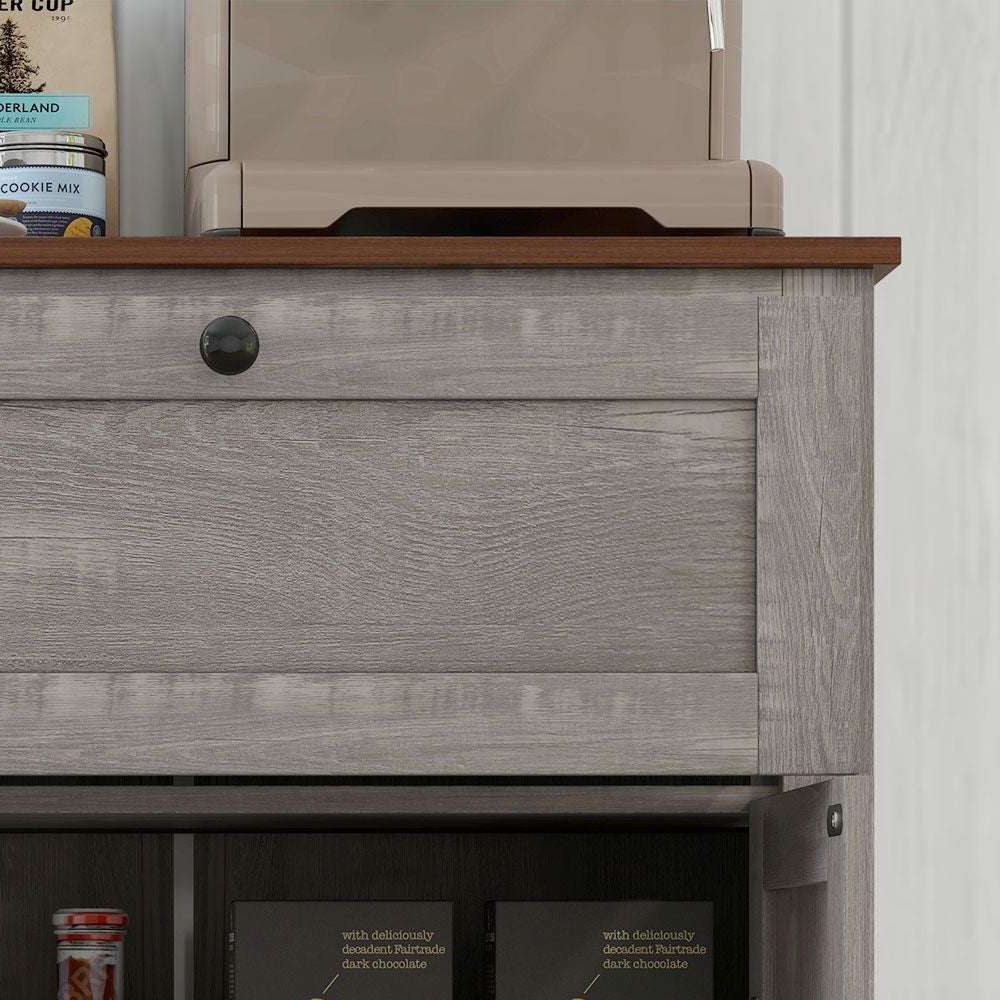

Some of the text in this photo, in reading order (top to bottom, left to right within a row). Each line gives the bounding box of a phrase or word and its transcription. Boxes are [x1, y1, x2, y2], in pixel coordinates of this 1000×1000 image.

[31, 0, 73, 11] CUP
[14, 116, 38, 124] BEAN
[0, 182, 53, 194] COOKIE
[57, 183, 81, 195] MIX
[343, 930, 433, 942] with deliciously
[603, 930, 695, 941] with deliciously
[343, 944, 445, 955] decadent Fairtrade
[603, 944, 706, 955] decadent Fairtrade
[342, 959, 426, 969] dark chocolate
[604, 959, 688, 969] dark chocolate
